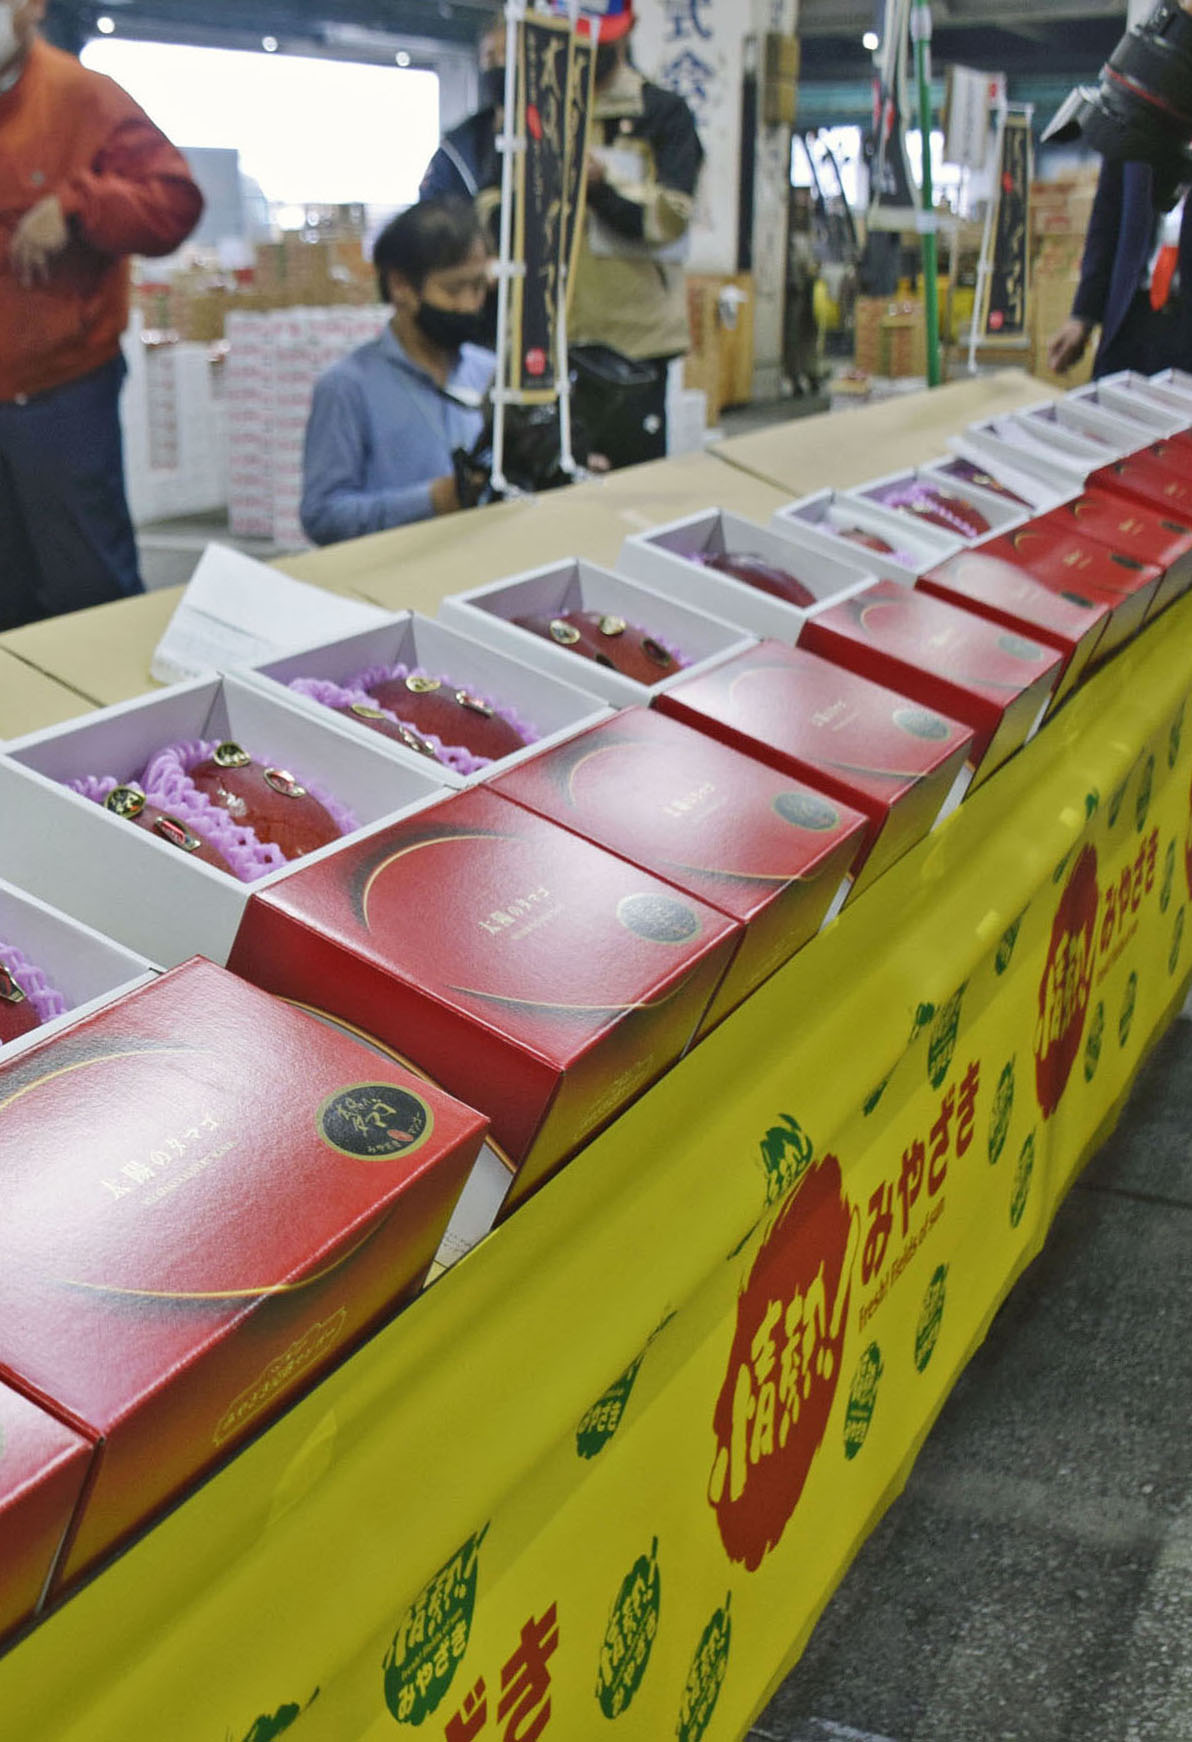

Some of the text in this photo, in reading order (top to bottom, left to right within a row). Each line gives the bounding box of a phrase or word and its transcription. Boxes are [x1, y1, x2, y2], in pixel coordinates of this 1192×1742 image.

[862, 1059, 980, 1286] みやざき
[398, 1619, 467, 1720] みやざき
